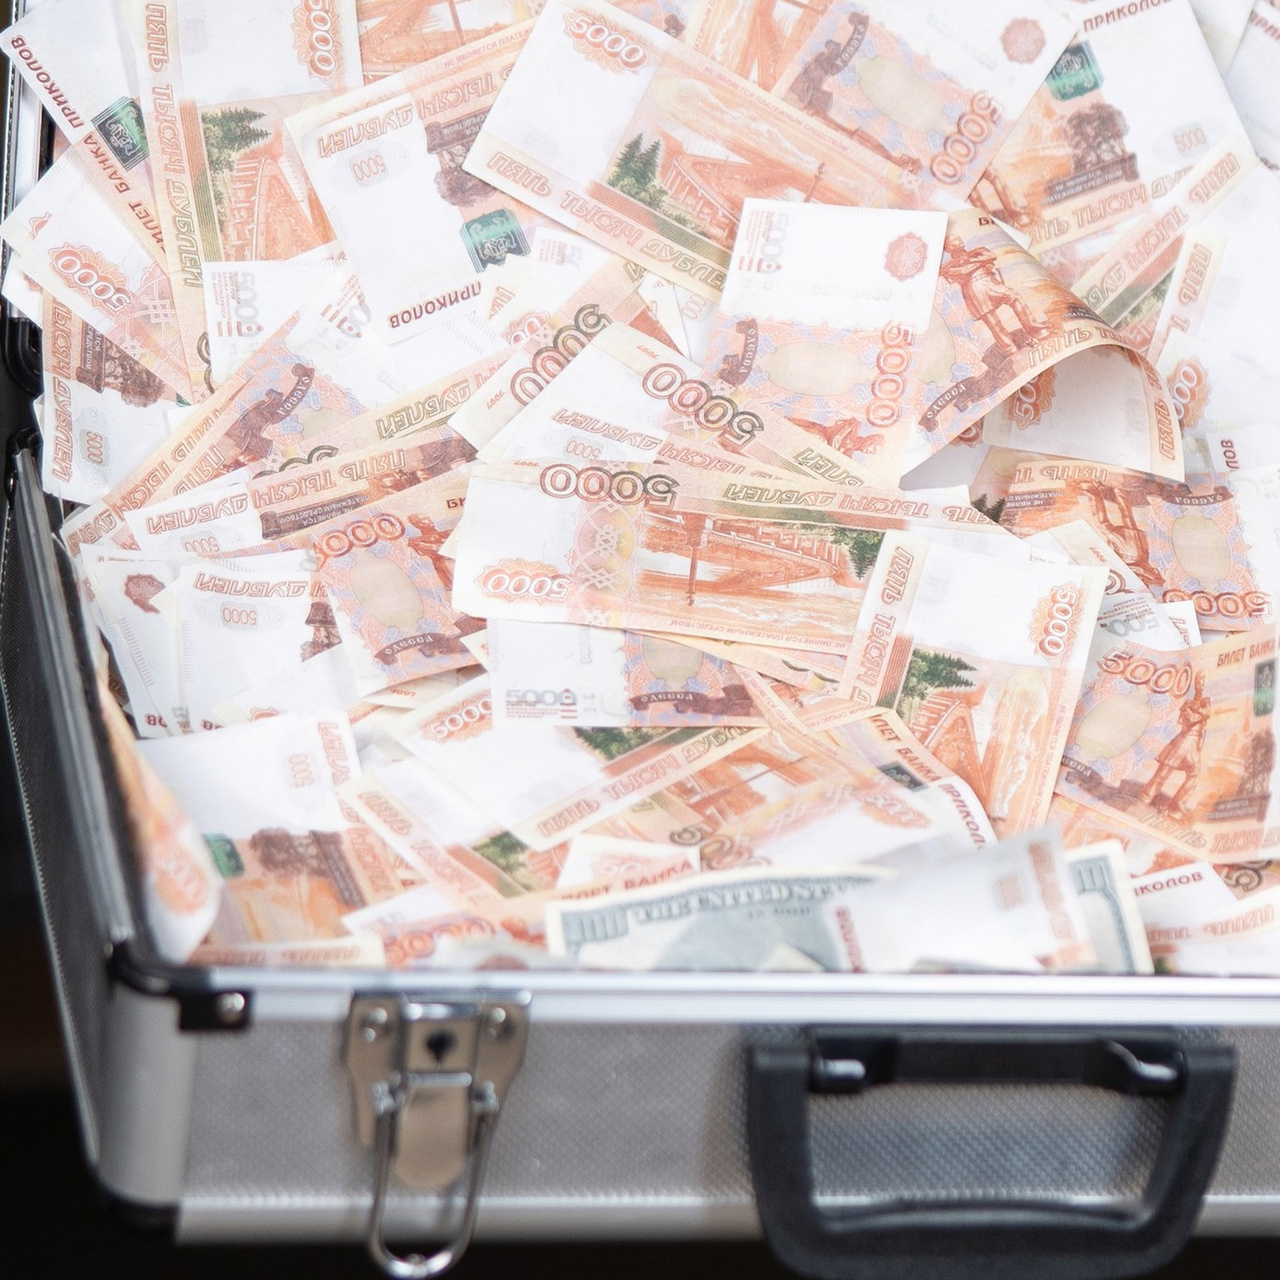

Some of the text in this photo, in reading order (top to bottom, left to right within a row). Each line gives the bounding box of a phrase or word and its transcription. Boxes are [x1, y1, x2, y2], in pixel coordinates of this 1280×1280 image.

[568, 16, 643, 63] 5000
[11, 36, 166, 256] ИЛЕТ БАНКА ПРИКОЛОВ
[145, 3, 203, 288] ПЯТЬ ТЫСЯЧ ДУБЛЕЙ
[317, 73, 498, 160] ТЫСЯЧ ДУБЛЕЙ
[931, 88, 1005, 187] 5000
[1189, 152, 1242, 203] ПЯТЬ
[487, 152, 729, 290] ПЯТЬ ТЫСЯЧ ДУБЛЕ
[1026, 213, 1069, 246] ЯТЬ
[1073, 182, 1149, 226] ТЫСЯЧ
[1125, 204, 1189, 264] ТЫСЯЧ
[57, 249, 131, 313] 5000
[234, 271, 259, 338] 5000
[390, 281, 481, 329] ПРИКОЛОВ
[1177, 243, 1213, 307] ПЯТЬ
[866, 320, 913, 428] 5000
[1028, 326, 1091, 366] ПЯТЬ
[53, 379, 72, 481] ДУБЛЕЙ
[377, 379, 471, 440] ДУБЛЕЙ
[642, 362, 764, 451] 5000
[552, 408, 745, 476] ТЫСЯЧ ДУБЛЕЙ
[111, 458, 172, 516] ТЫСЯЧ
[148, 448, 406, 535] ПЯТЬ ТЫСЯЧ ДУБЛЕЙ
[174, 446, 225, 499] ПЯТЬ
[540, 462, 680, 508] 5000
[724, 484, 835, 508] ДУБЛЕЙ
[837, 489, 928, 518] ТЫСЯЧ
[315, 513, 406, 561] 000
[193, 572, 309, 598] ДУБЛЕЙ
[486, 573, 571, 598] 5000
[857, 545, 915, 687] ПЯТЬ ТЫСЯЧ
[1039, 586, 1077, 655] 5000
[504, 687, 578, 707] 5000
[1100, 653, 1192, 695] 5000
[427, 693, 494, 736] 5000
[685, 726, 755, 762] ДУБ
[874, 716, 986, 848] ЛЕТ БАНКА ПРИКОЛ
[1134, 873, 1202, 895] КОЛОВ
